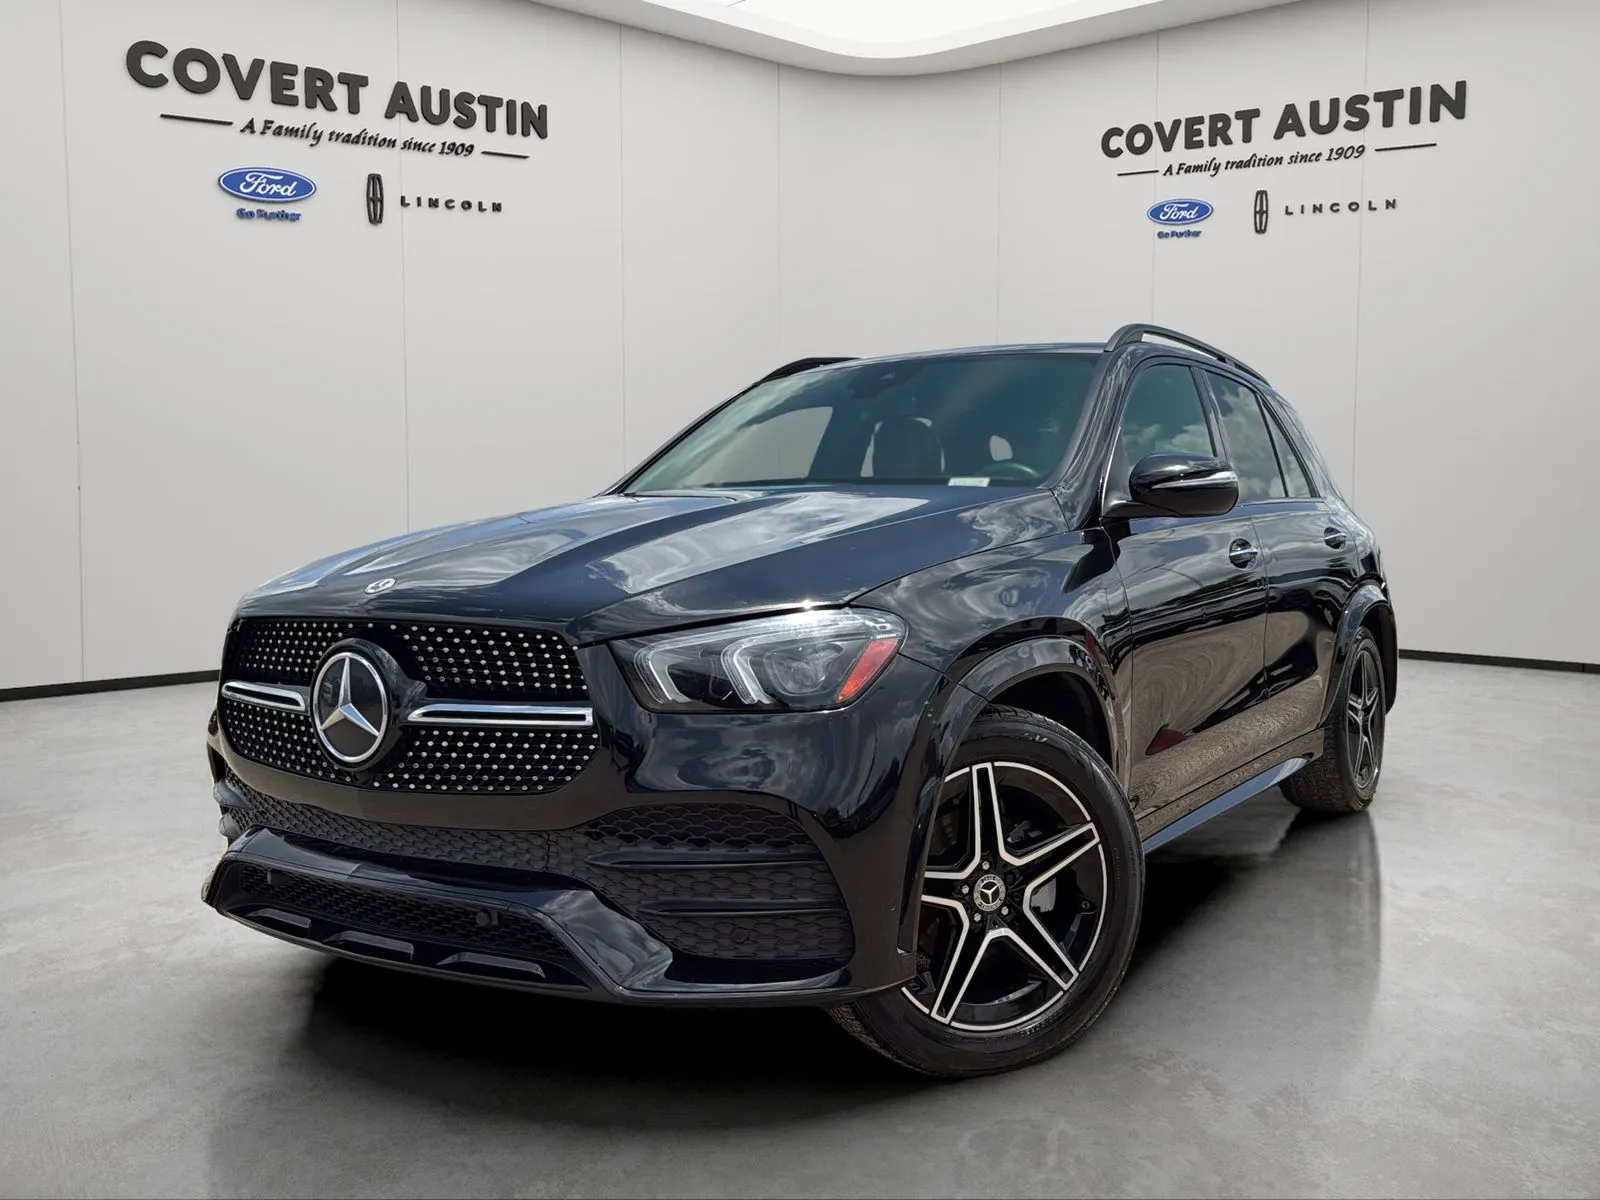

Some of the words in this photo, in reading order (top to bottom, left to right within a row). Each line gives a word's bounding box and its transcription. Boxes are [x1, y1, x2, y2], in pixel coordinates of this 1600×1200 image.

[125, 40, 369, 116] COVERT
[384, 80, 548, 140] AUSTIN
[1100, 107, 1261, 159] COVERT
[1272, 80, 1467, 141] AUSTIN
[239, 117, 257, 135] A
[259, 119, 324, 147] Family
[328, 128, 398, 149] tradition
[400, 138, 437, 154] since
[438, 140, 475, 157] 1909
[1162, 163, 1174, 177] A
[1175, 156, 1222, 178] Family
[1224, 152, 1284, 171] tradition
[1287, 149, 1323, 165] since
[1325, 144, 1366, 162] 1909
[239, 171, 298, 197] Ford
[400, 195, 502, 213] LINCOLN
[1159, 203, 1199, 220] Ford
[1284, 198, 1397, 216] LINCOLN
